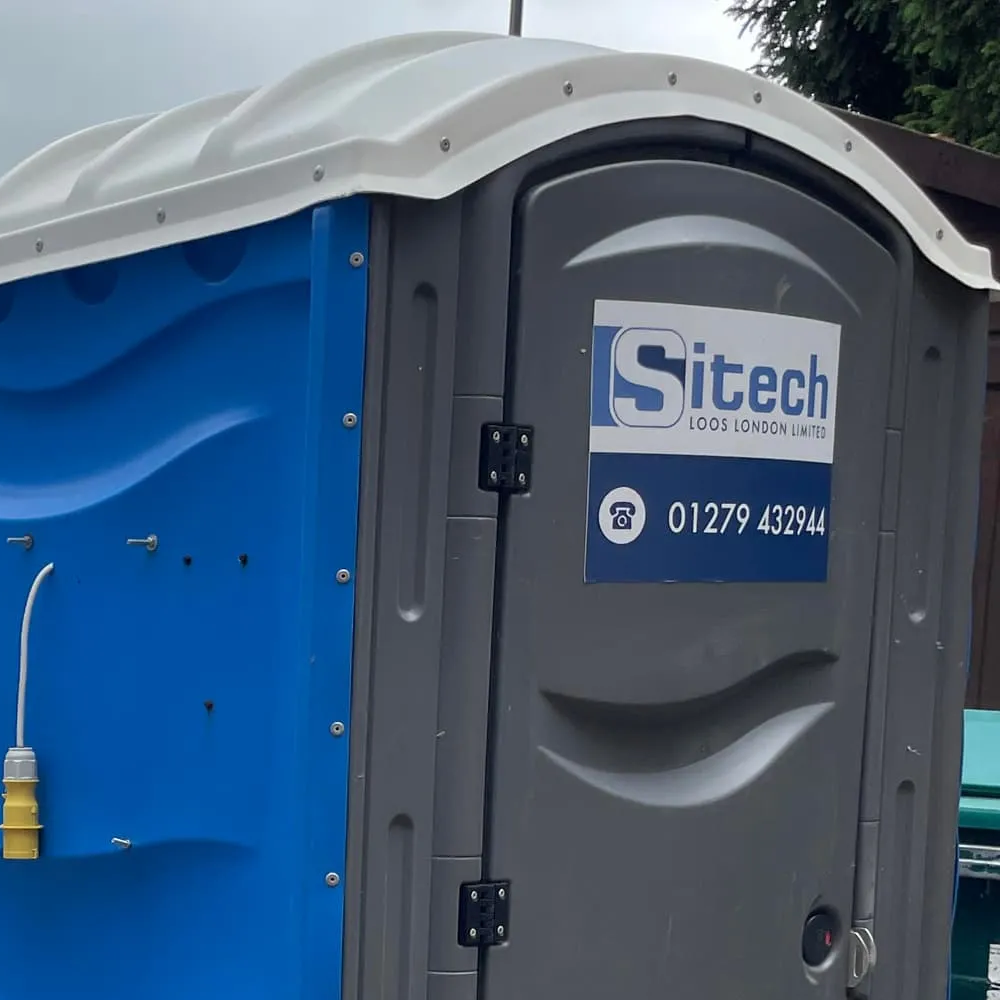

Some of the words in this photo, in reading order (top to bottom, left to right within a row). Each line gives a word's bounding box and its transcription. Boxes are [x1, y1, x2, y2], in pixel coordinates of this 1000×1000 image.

[613, 327, 829, 428] Sitech
[689, 416, 728, 432] LOOS
[734, 419, 788, 436] LONDON
[791, 425, 826, 439] LIMITED
[667, 501, 751, 534] 01279
[756, 503, 826, 536] 432944
